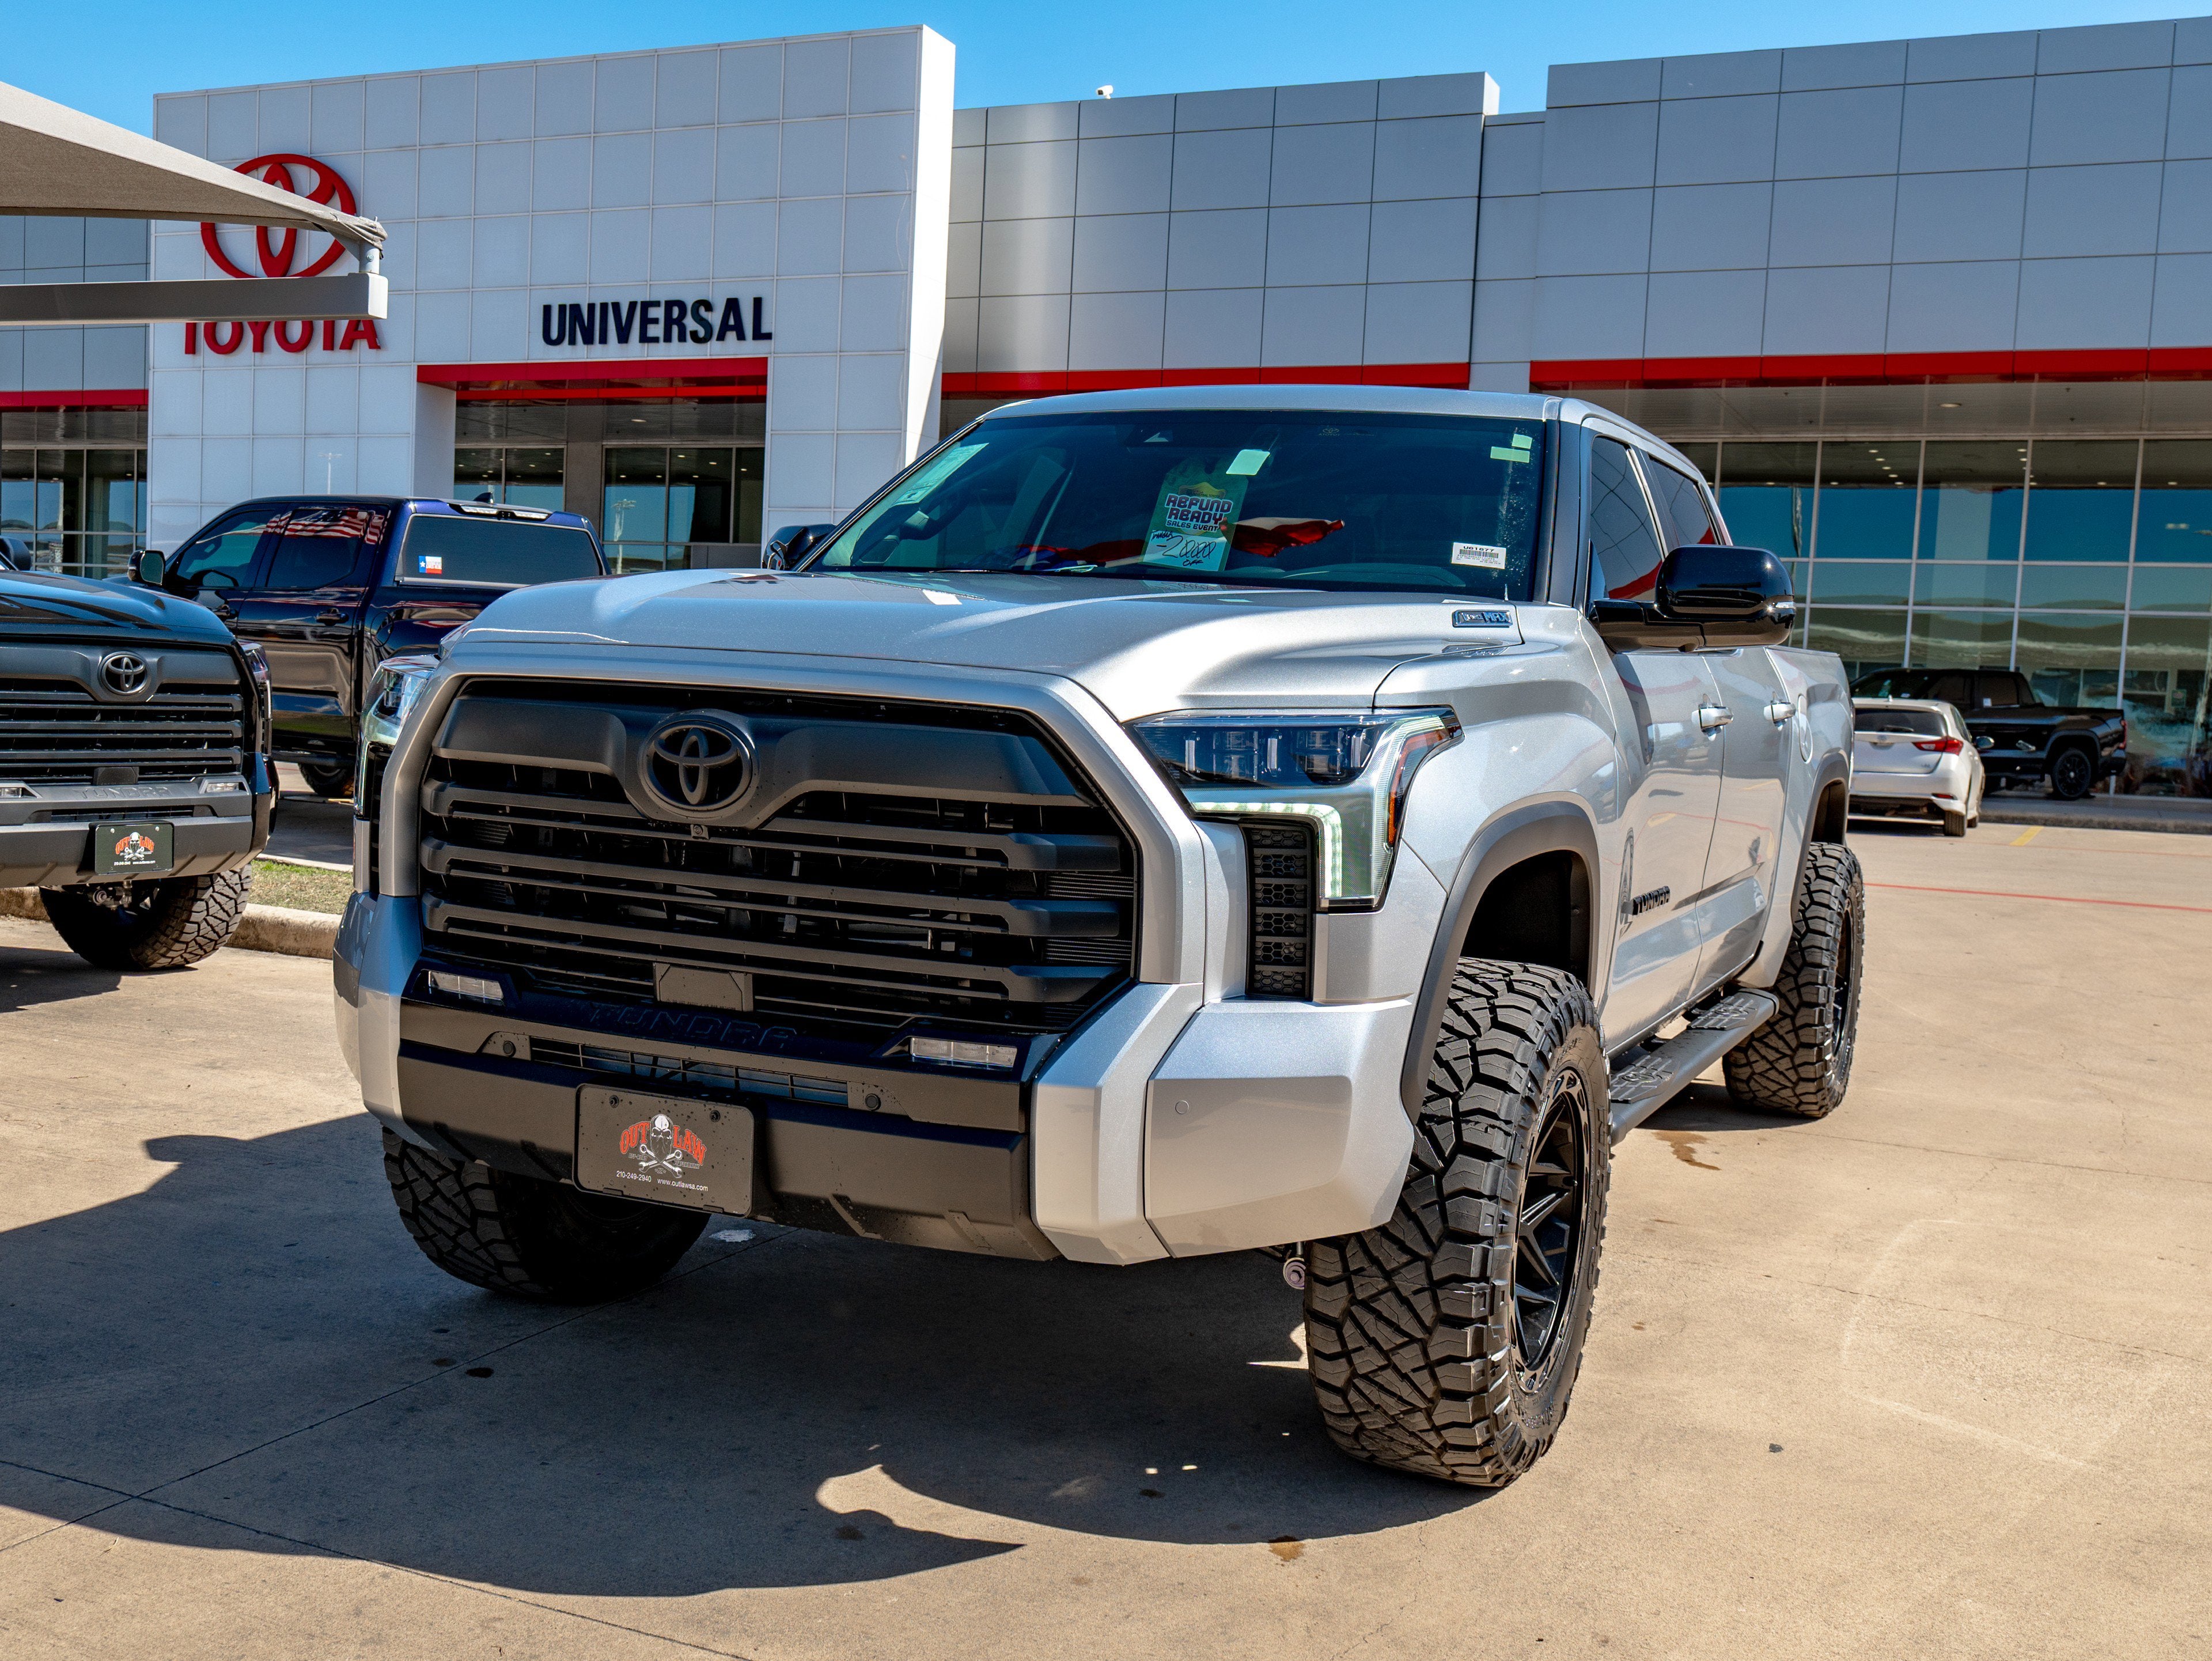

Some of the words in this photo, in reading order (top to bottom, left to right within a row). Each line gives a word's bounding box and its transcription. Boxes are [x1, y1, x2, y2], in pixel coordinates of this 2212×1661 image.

[542, 297, 772, 346] UNIVERSAL
[1165, 494, 1233, 513] REFUND
[1166, 520, 1191, 529] SALES
[1167, 508, 1224, 525] READY
[73, 787, 173, 799] TUNDRA
[589, 1001, 798, 1049] TUNDRA
[620, 1121, 651, 1154] OUT
[616, 1170, 652, 1182] 210-249-2940
[657, 1178, 709, 1191] www.outlawsa.com
